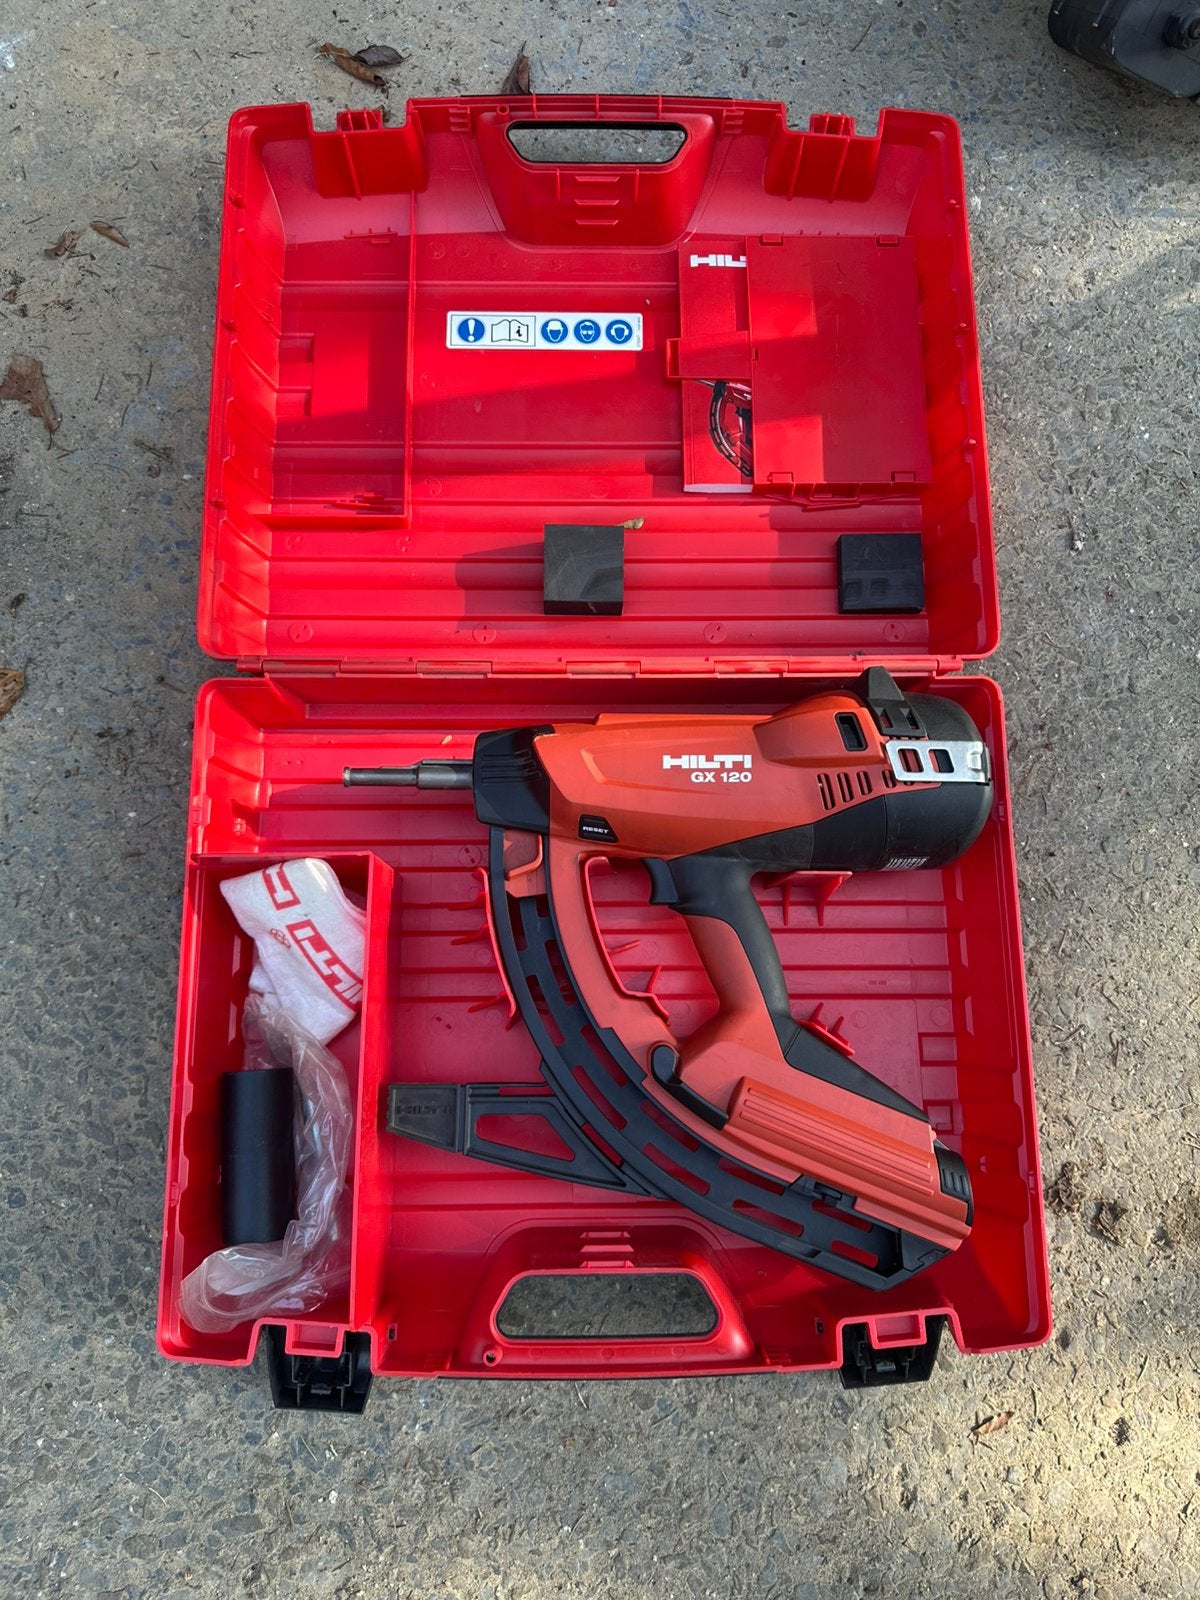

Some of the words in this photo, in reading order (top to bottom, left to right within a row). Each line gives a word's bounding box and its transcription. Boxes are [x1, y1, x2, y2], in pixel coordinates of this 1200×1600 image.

[690, 254, 747, 268] HIL
[662, 754, 752, 769] HILTI
[690, 771, 716, 783] GX
[720, 771, 752, 783] 120
[582, 825, 609, 834] RESET
